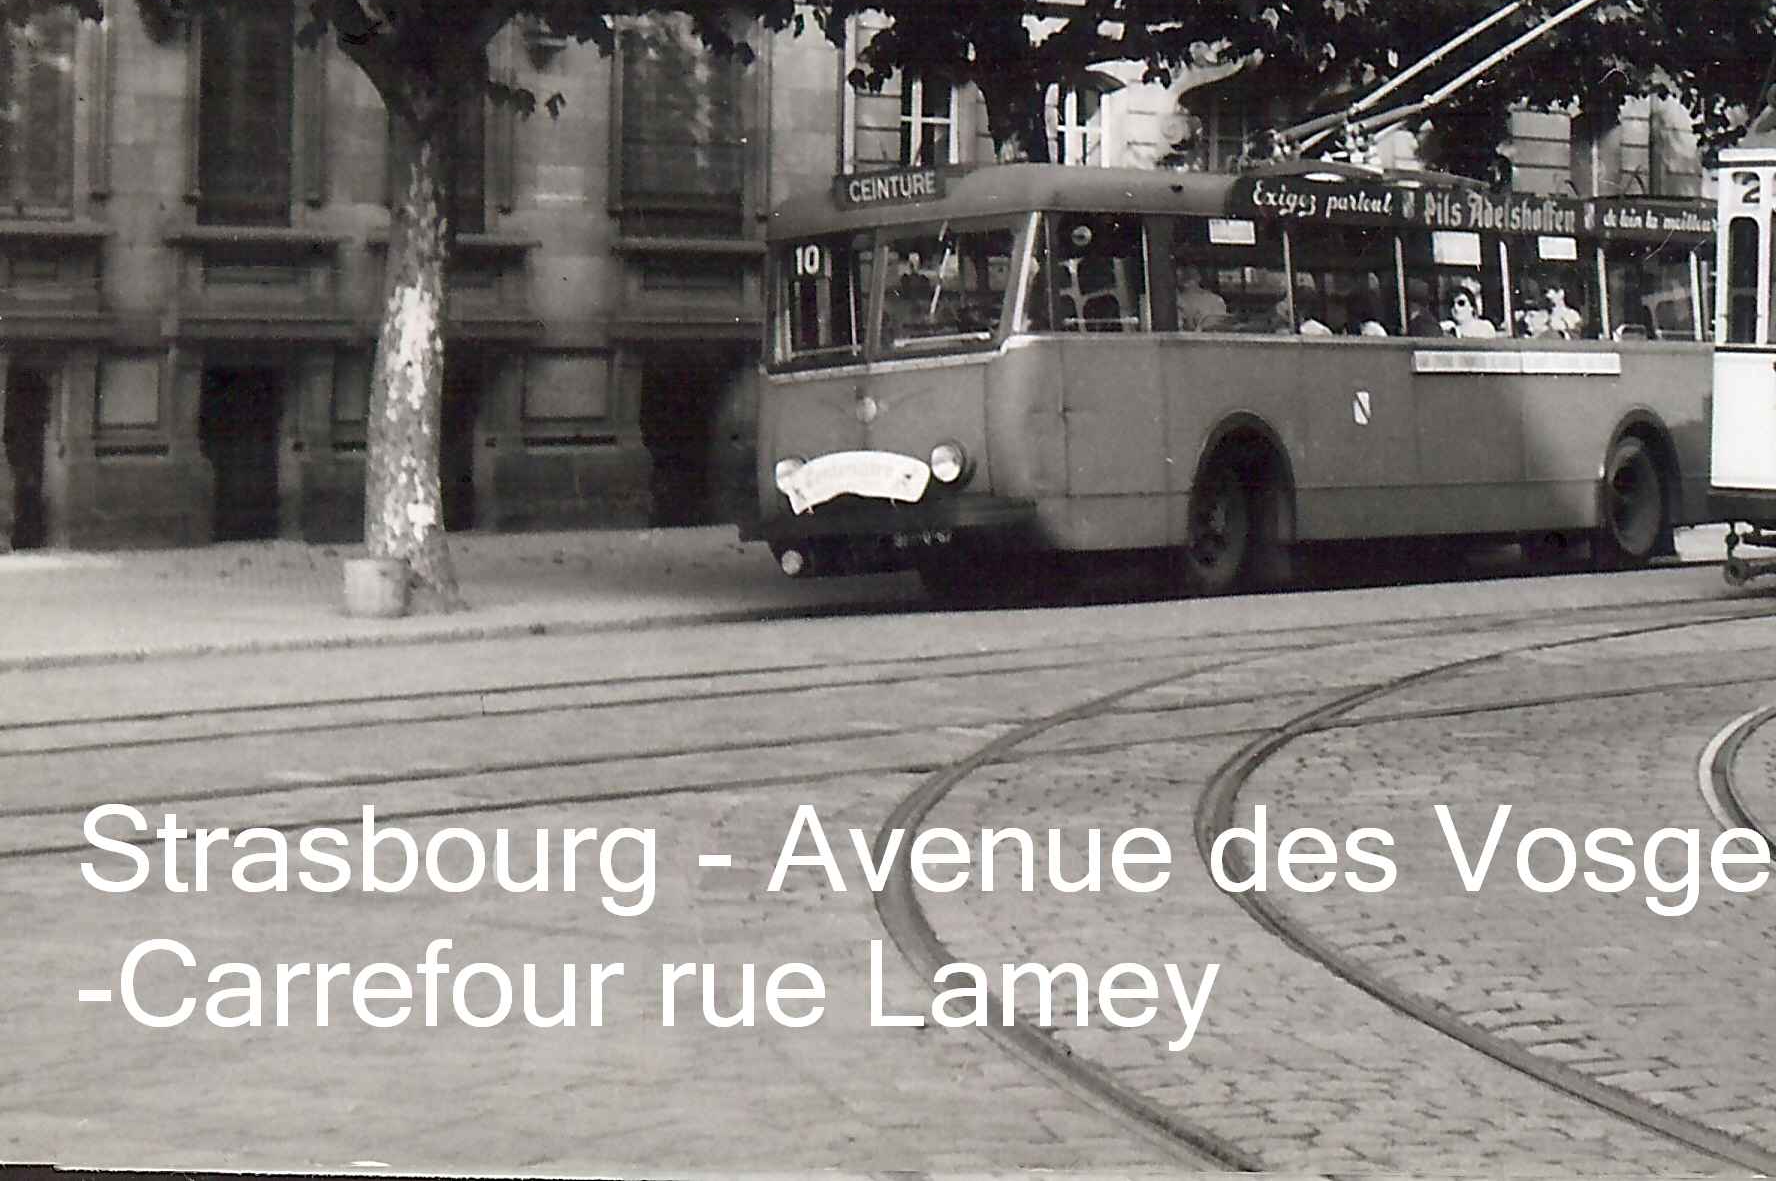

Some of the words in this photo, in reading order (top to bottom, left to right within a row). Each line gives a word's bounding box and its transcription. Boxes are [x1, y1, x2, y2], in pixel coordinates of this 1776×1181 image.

[849, 170, 936, 202] CEINTURE
[1732, 171, 1761, 204] 2
[1253, 179, 1317, 217] Exigez
[1424, 191, 1462, 226] Pils
[796, 244, 820, 275] 10
